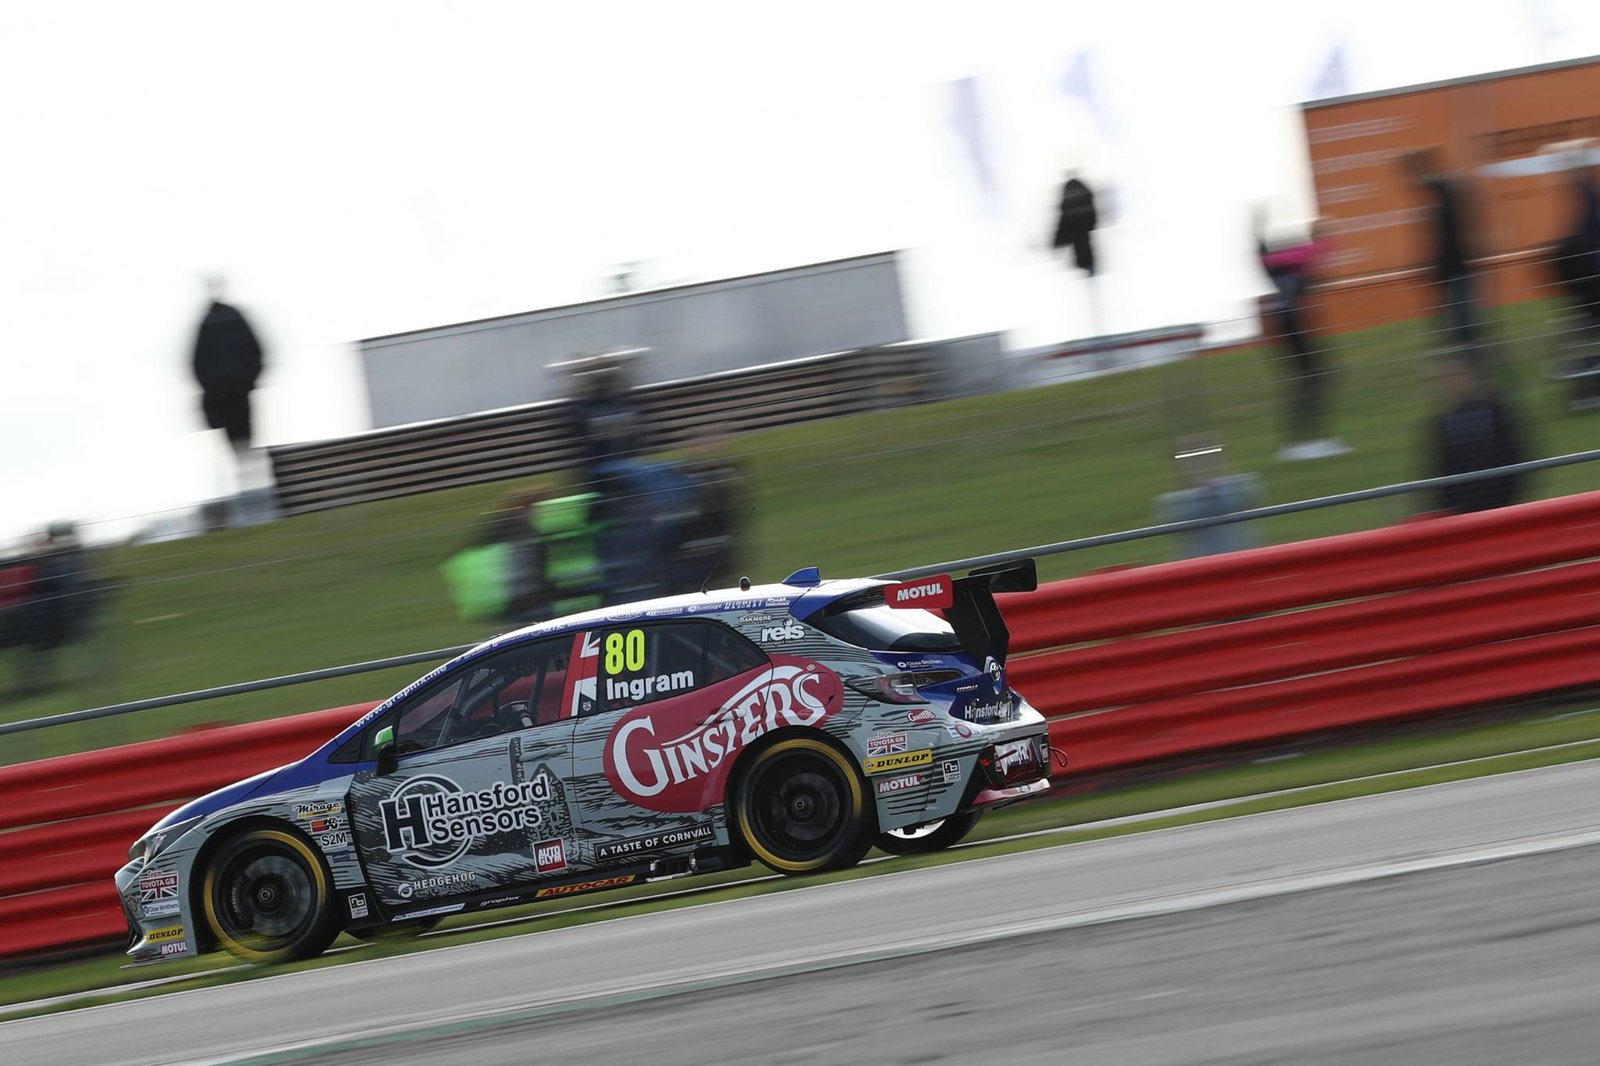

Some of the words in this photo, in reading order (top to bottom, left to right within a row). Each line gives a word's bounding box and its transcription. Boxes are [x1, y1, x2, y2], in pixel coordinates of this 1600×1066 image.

[897, 583, 943, 601] MOTUL
[761, 618, 805, 642] reis
[605, 629, 646, 676] 80
[606, 670, 695, 701] Ingram
[870, 738, 895, 747] TOYOTA
[876, 753, 929, 768] DUNLOP
[879, 776, 920, 793] MOTUL
[426, 774, 550, 818] Hansford
[297, 802, 340, 813] Mirage
[431, 806, 541, 844] Sensors
[321, 832, 346, 847] S2M
[600, 848, 608, 857] A
[610, 840, 642, 854] TASTE
[645, 838, 659, 848] OF
[538, 845, 561, 859] AUTO
[538, 853, 562, 867] GLYM
[141, 879, 165, 889] TOYOTA
[165, 878, 176, 886] GB
[414, 871, 475, 889] HEDGEHOG
[544, 876, 630, 896] AUTOCAR
[149, 928, 184, 940] DUNLOP
[162, 942, 187, 955] MOTUL
